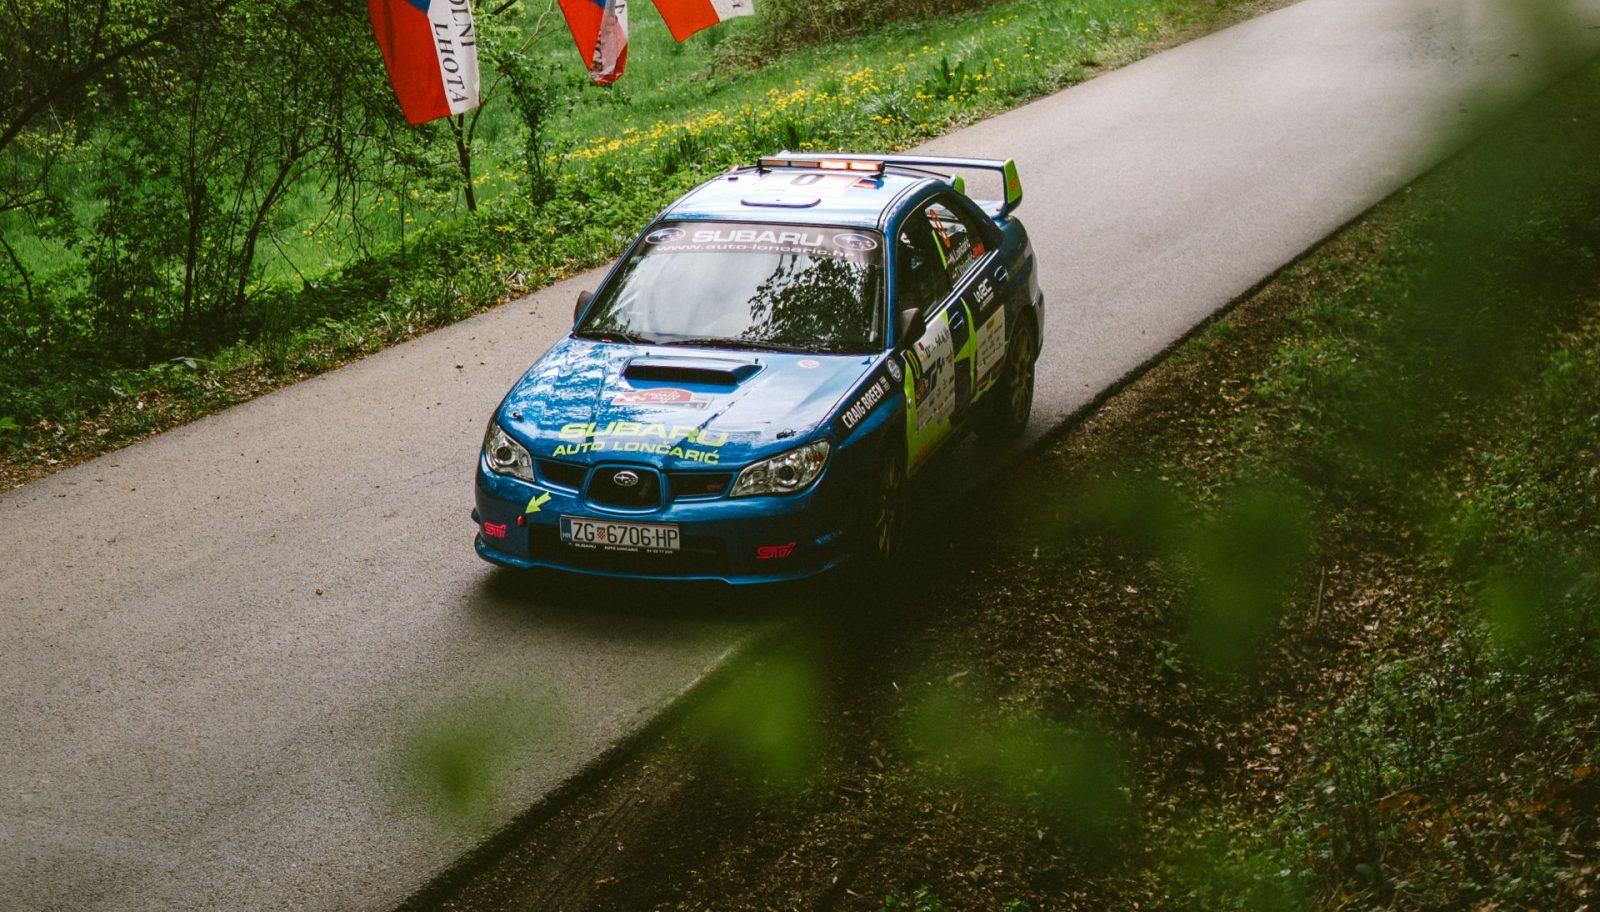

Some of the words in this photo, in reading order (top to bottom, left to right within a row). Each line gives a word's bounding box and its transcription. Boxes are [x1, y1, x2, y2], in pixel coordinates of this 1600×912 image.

[434, 23, 469, 102] LHOTA
[656, 243, 855, 258] www.auto-loncaric.hr
[691, 229, 824, 247] SUBARU
[841, 400, 866, 429] CRAIG
[860, 382, 885, 410] BREEN
[558, 421, 729, 447] SUBARU
[552, 442, 605, 457] AUTO
[612, 439, 720, 465] LONČARIĆ
[572, 522, 595, 541] ZG
